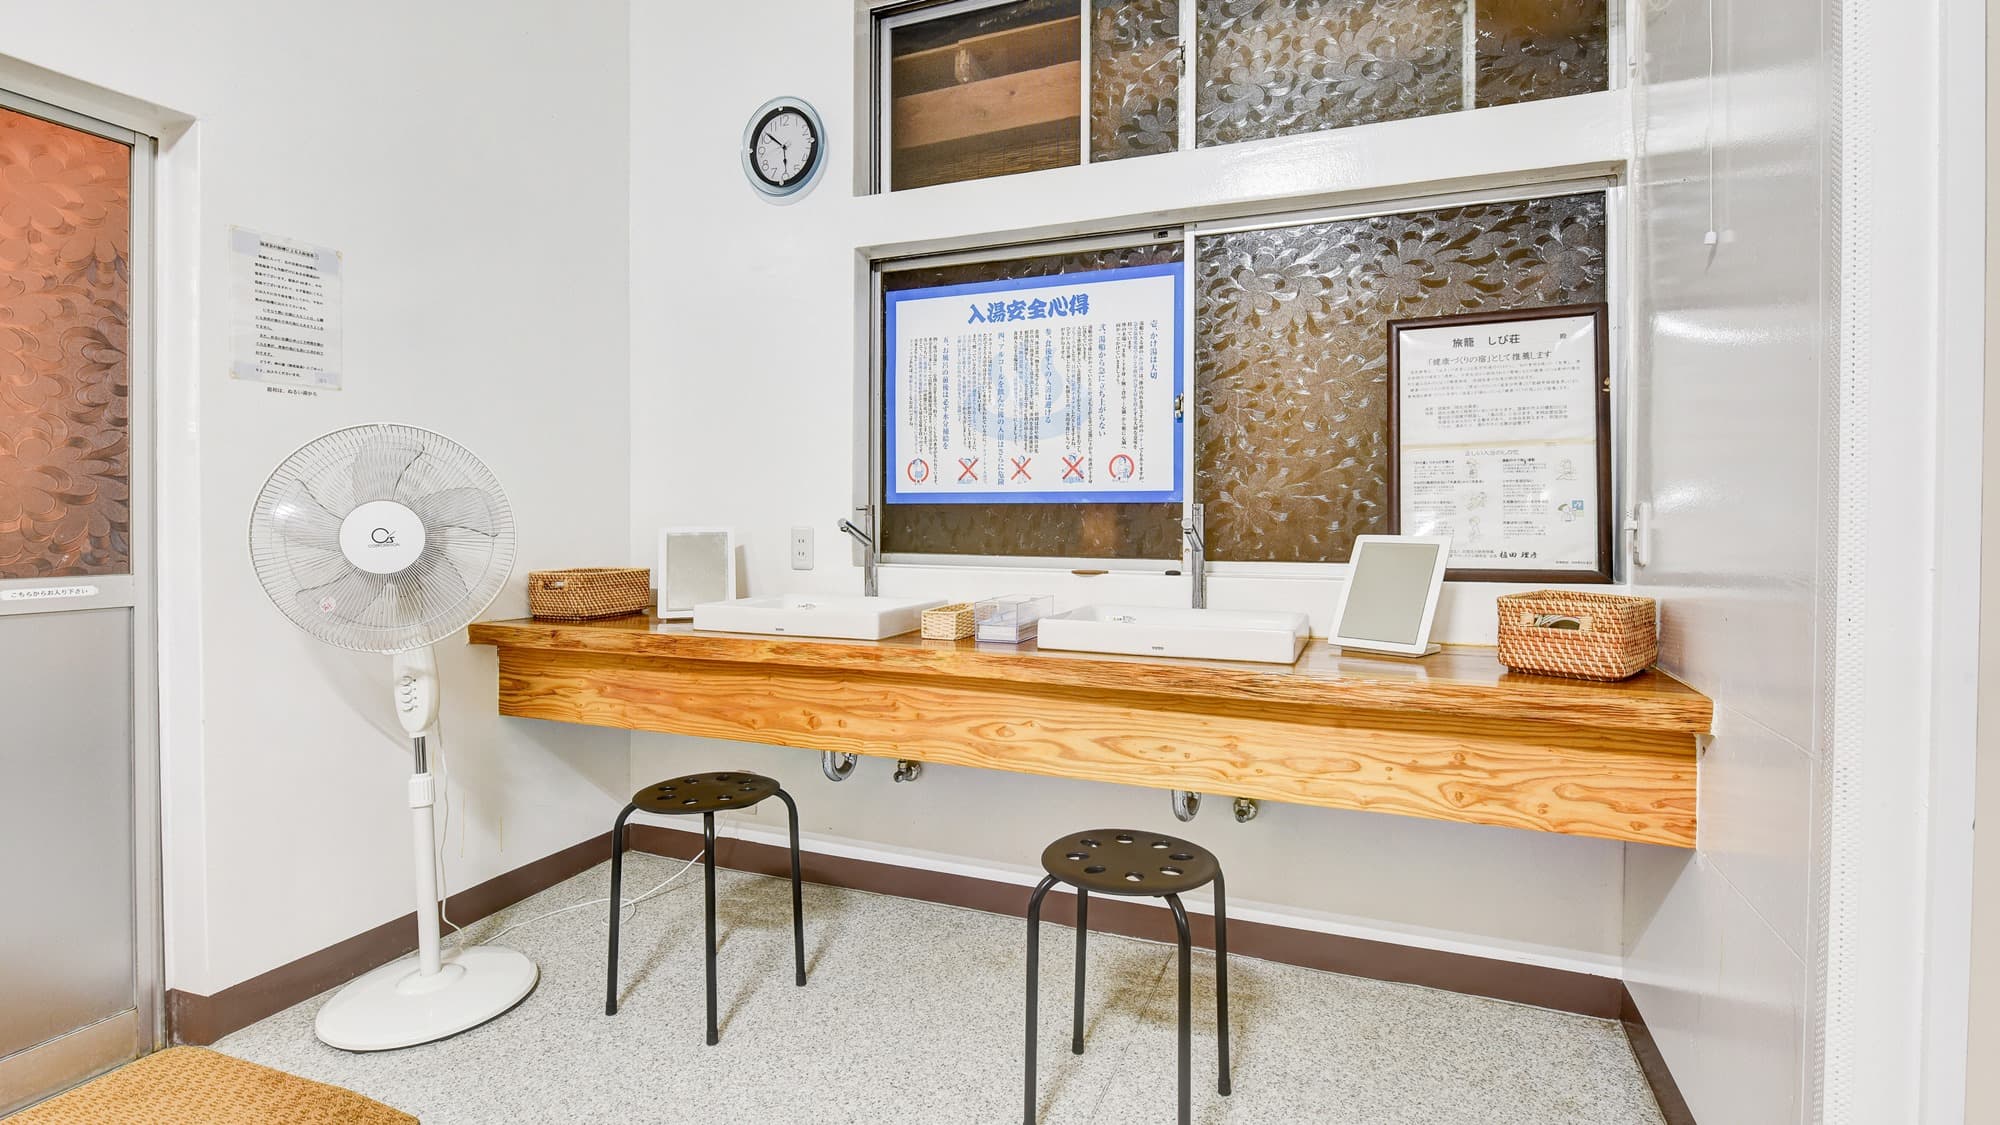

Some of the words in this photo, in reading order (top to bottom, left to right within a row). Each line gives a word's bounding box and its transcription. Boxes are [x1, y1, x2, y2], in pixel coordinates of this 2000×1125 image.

[770, 121, 777, 132] 11
[779, 115, 789, 126] 12
[761, 133, 771, 144] 10
[758, 146, 766, 158] 9
[761, 159, 769, 171] 8
[771, 167, 777, 179] 7
[968, 293, 1089, 324] 入湯安全心得
[1488, 334, 1521, 346] しび荘
[10, 588, 89, 599] こちらからお入り下さい
